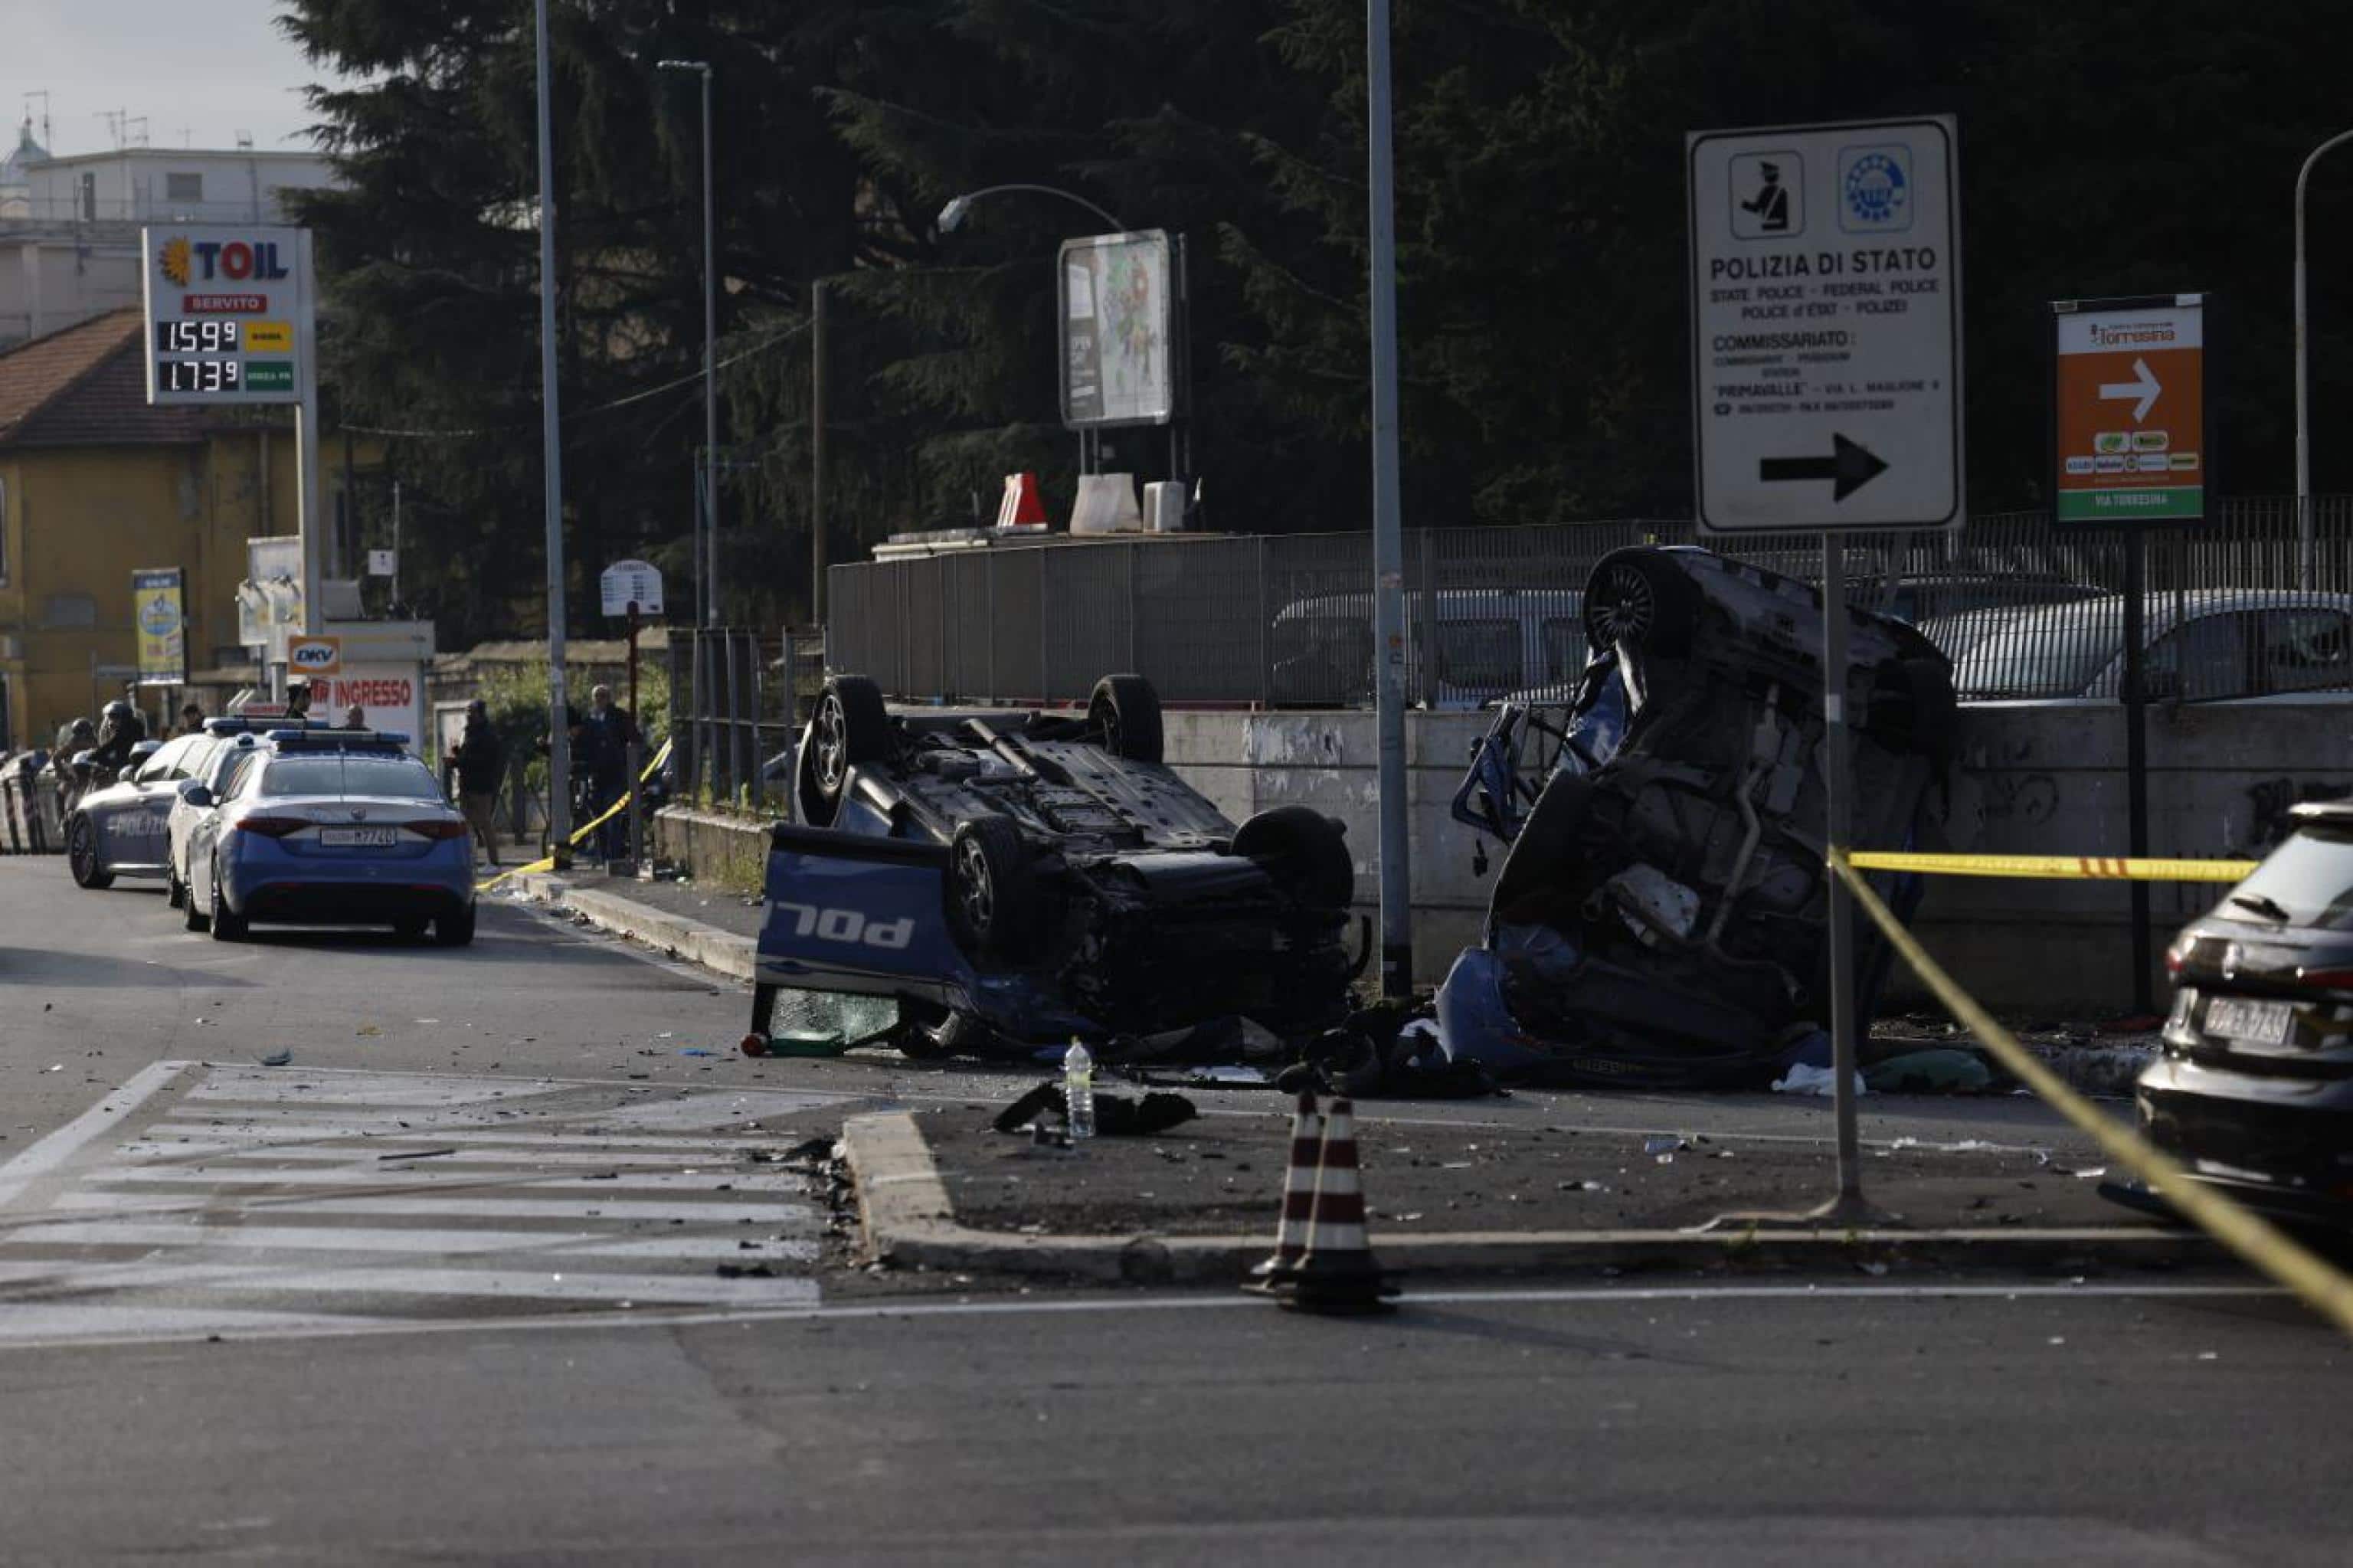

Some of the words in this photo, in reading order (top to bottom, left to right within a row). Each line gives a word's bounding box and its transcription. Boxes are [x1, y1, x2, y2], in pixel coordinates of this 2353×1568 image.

[194, 241, 290, 280] TOIL
[1710, 254, 1810, 280] POLIZIA
[1818, 252, 1843, 275] DI
[1851, 246, 1936, 273] STATO
[191, 296, 260, 309] SERVITO
[1710, 287, 1749, 303] STATE
[1756, 285, 1804, 300] POLICE
[1823, 281, 1883, 297] FEDERAL
[1890, 278, 1940, 294] POLICE
[1741, 305, 1788, 320] POLICE
[1855, 298, 1908, 314] POLIZEI
[296, 648, 332, 663] DKV
[335, 679, 412, 708] INGRESSO
